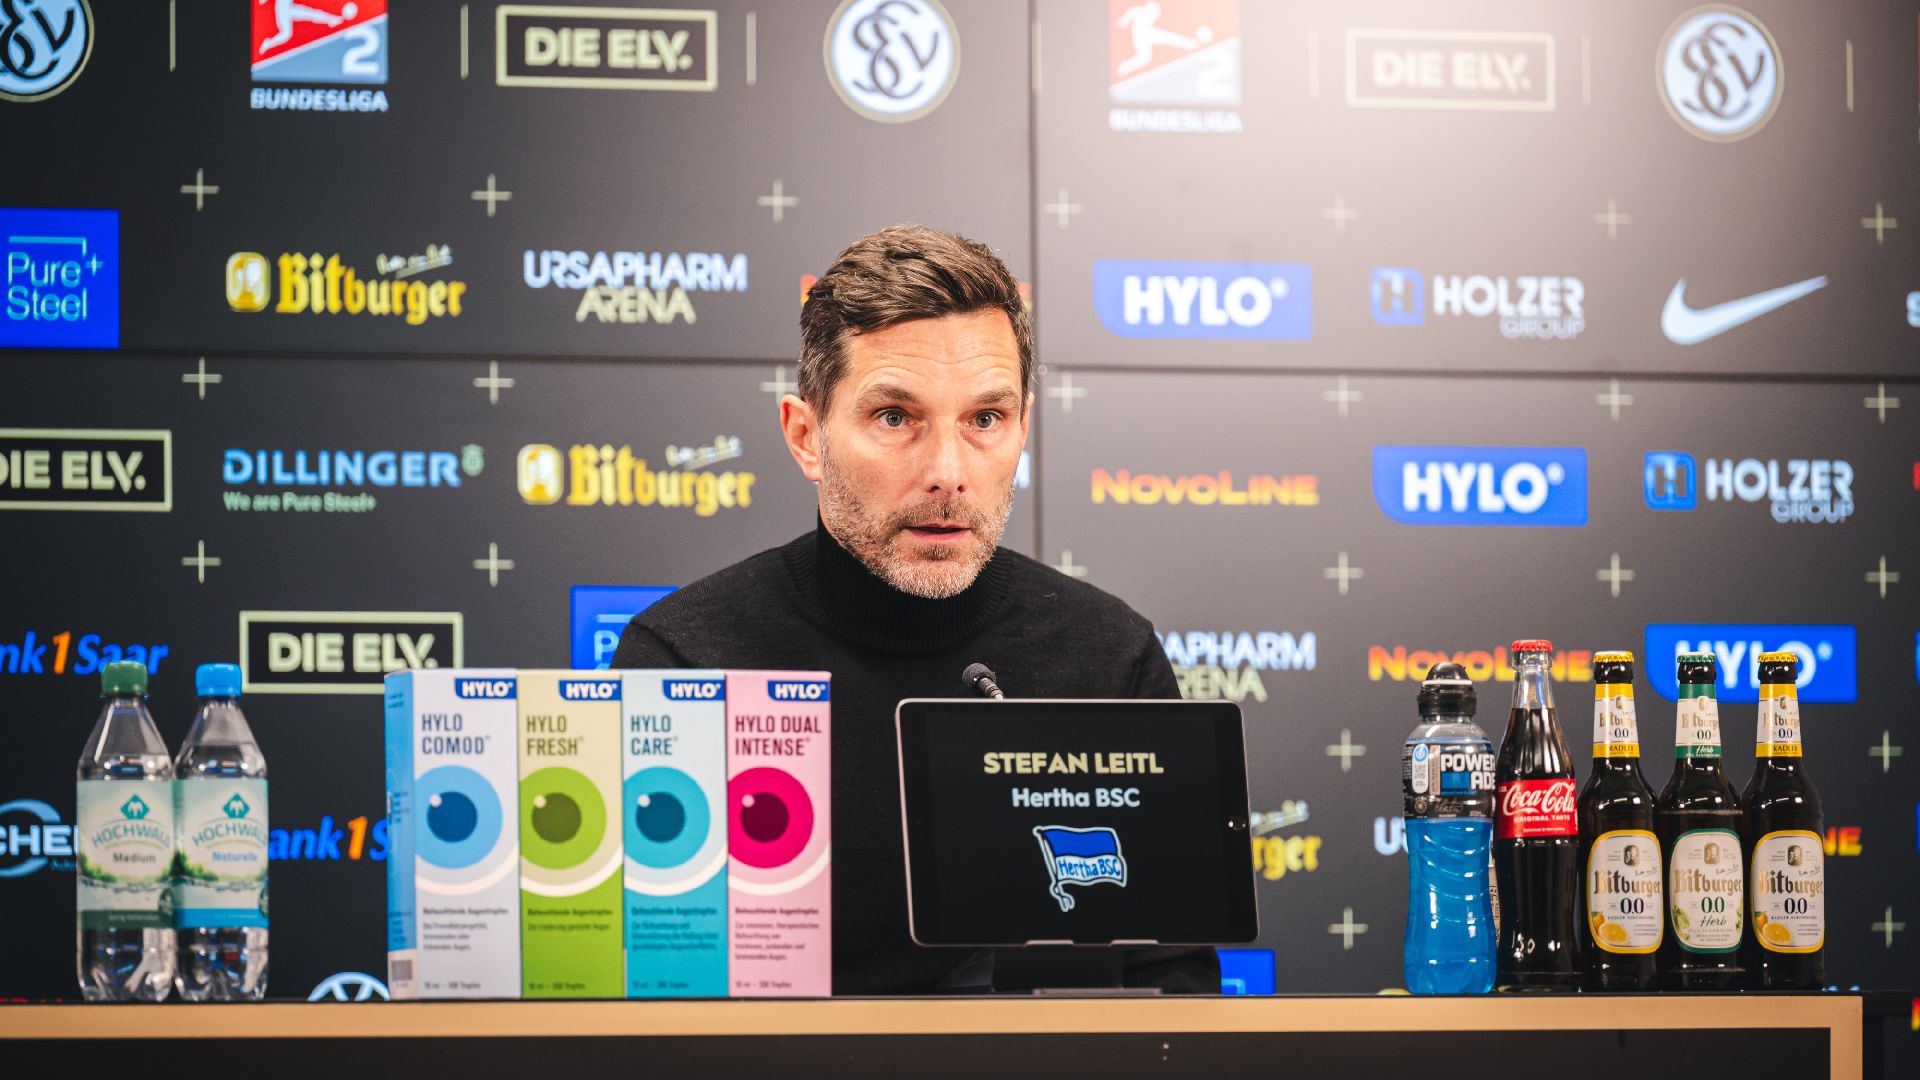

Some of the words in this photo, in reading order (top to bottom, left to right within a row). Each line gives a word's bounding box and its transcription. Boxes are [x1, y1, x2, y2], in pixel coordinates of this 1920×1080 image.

[342, 26, 381, 76] 2
[524, 27, 600, 67] DIE
[607, 29, 694, 73] ELV.
[1372, 49, 1445, 88] DIE
[250, 88, 389, 112] BUNDESLIGA
[1109, 108, 1243, 133] BUNDESLIGA
[523, 249, 749, 292] URSAPHARM
[276, 252, 468, 325] Bitburger
[1433, 275, 1585, 317] HOLZER
[6, 286, 88, 322] Steel
[575, 286, 697, 324] ARENA
[62, 450, 146, 493] ELV.
[223, 448, 462, 487] DILLINGER
[567, 443, 755, 517] Bitburger
[1705, 458, 1854, 502] HOLZER
[223, 491, 251, 511] We
[253, 496, 280, 511] are
[283, 492, 322, 512] Pure
[1771, 499, 1854, 524] GROUP
[0, 631, 47, 675] nk
[52, 631, 72, 675] 1
[269, 632, 345, 673] DIE
[1155, 631, 1317, 670] APHARM
[1171, 664, 1268, 703] RENA
[421, 713, 463, 732] HYLO
[526, 715, 567, 733] HYLO
[630, 715, 672, 733] HYLO
[735, 716, 776, 733] HYLO
[781, 716, 822, 734] DUAL
[983, 752, 1089, 774] STEFAN
[1094, 752, 1164, 774] LEITL
[1011, 788, 1090, 807] Hertha
[1095, 788, 1140, 807] BSC
[1503, 782, 1576, 816] Coca-Cola
[1514, 814, 1549, 823] ORIGINAL
[113, 853, 156, 863] Medium
[1594, 870, 1661, 898] Bitburger
[1674, 868, 1742, 897] Bitburger
[1758, 870, 1823, 897] Bitburger
[1620, 897, 1644, 914] 0.0
[1701, 896, 1725, 913] 0.0
[1784, 897, 1808, 914] 0.0
[1700, 915, 1727, 927] Herb
